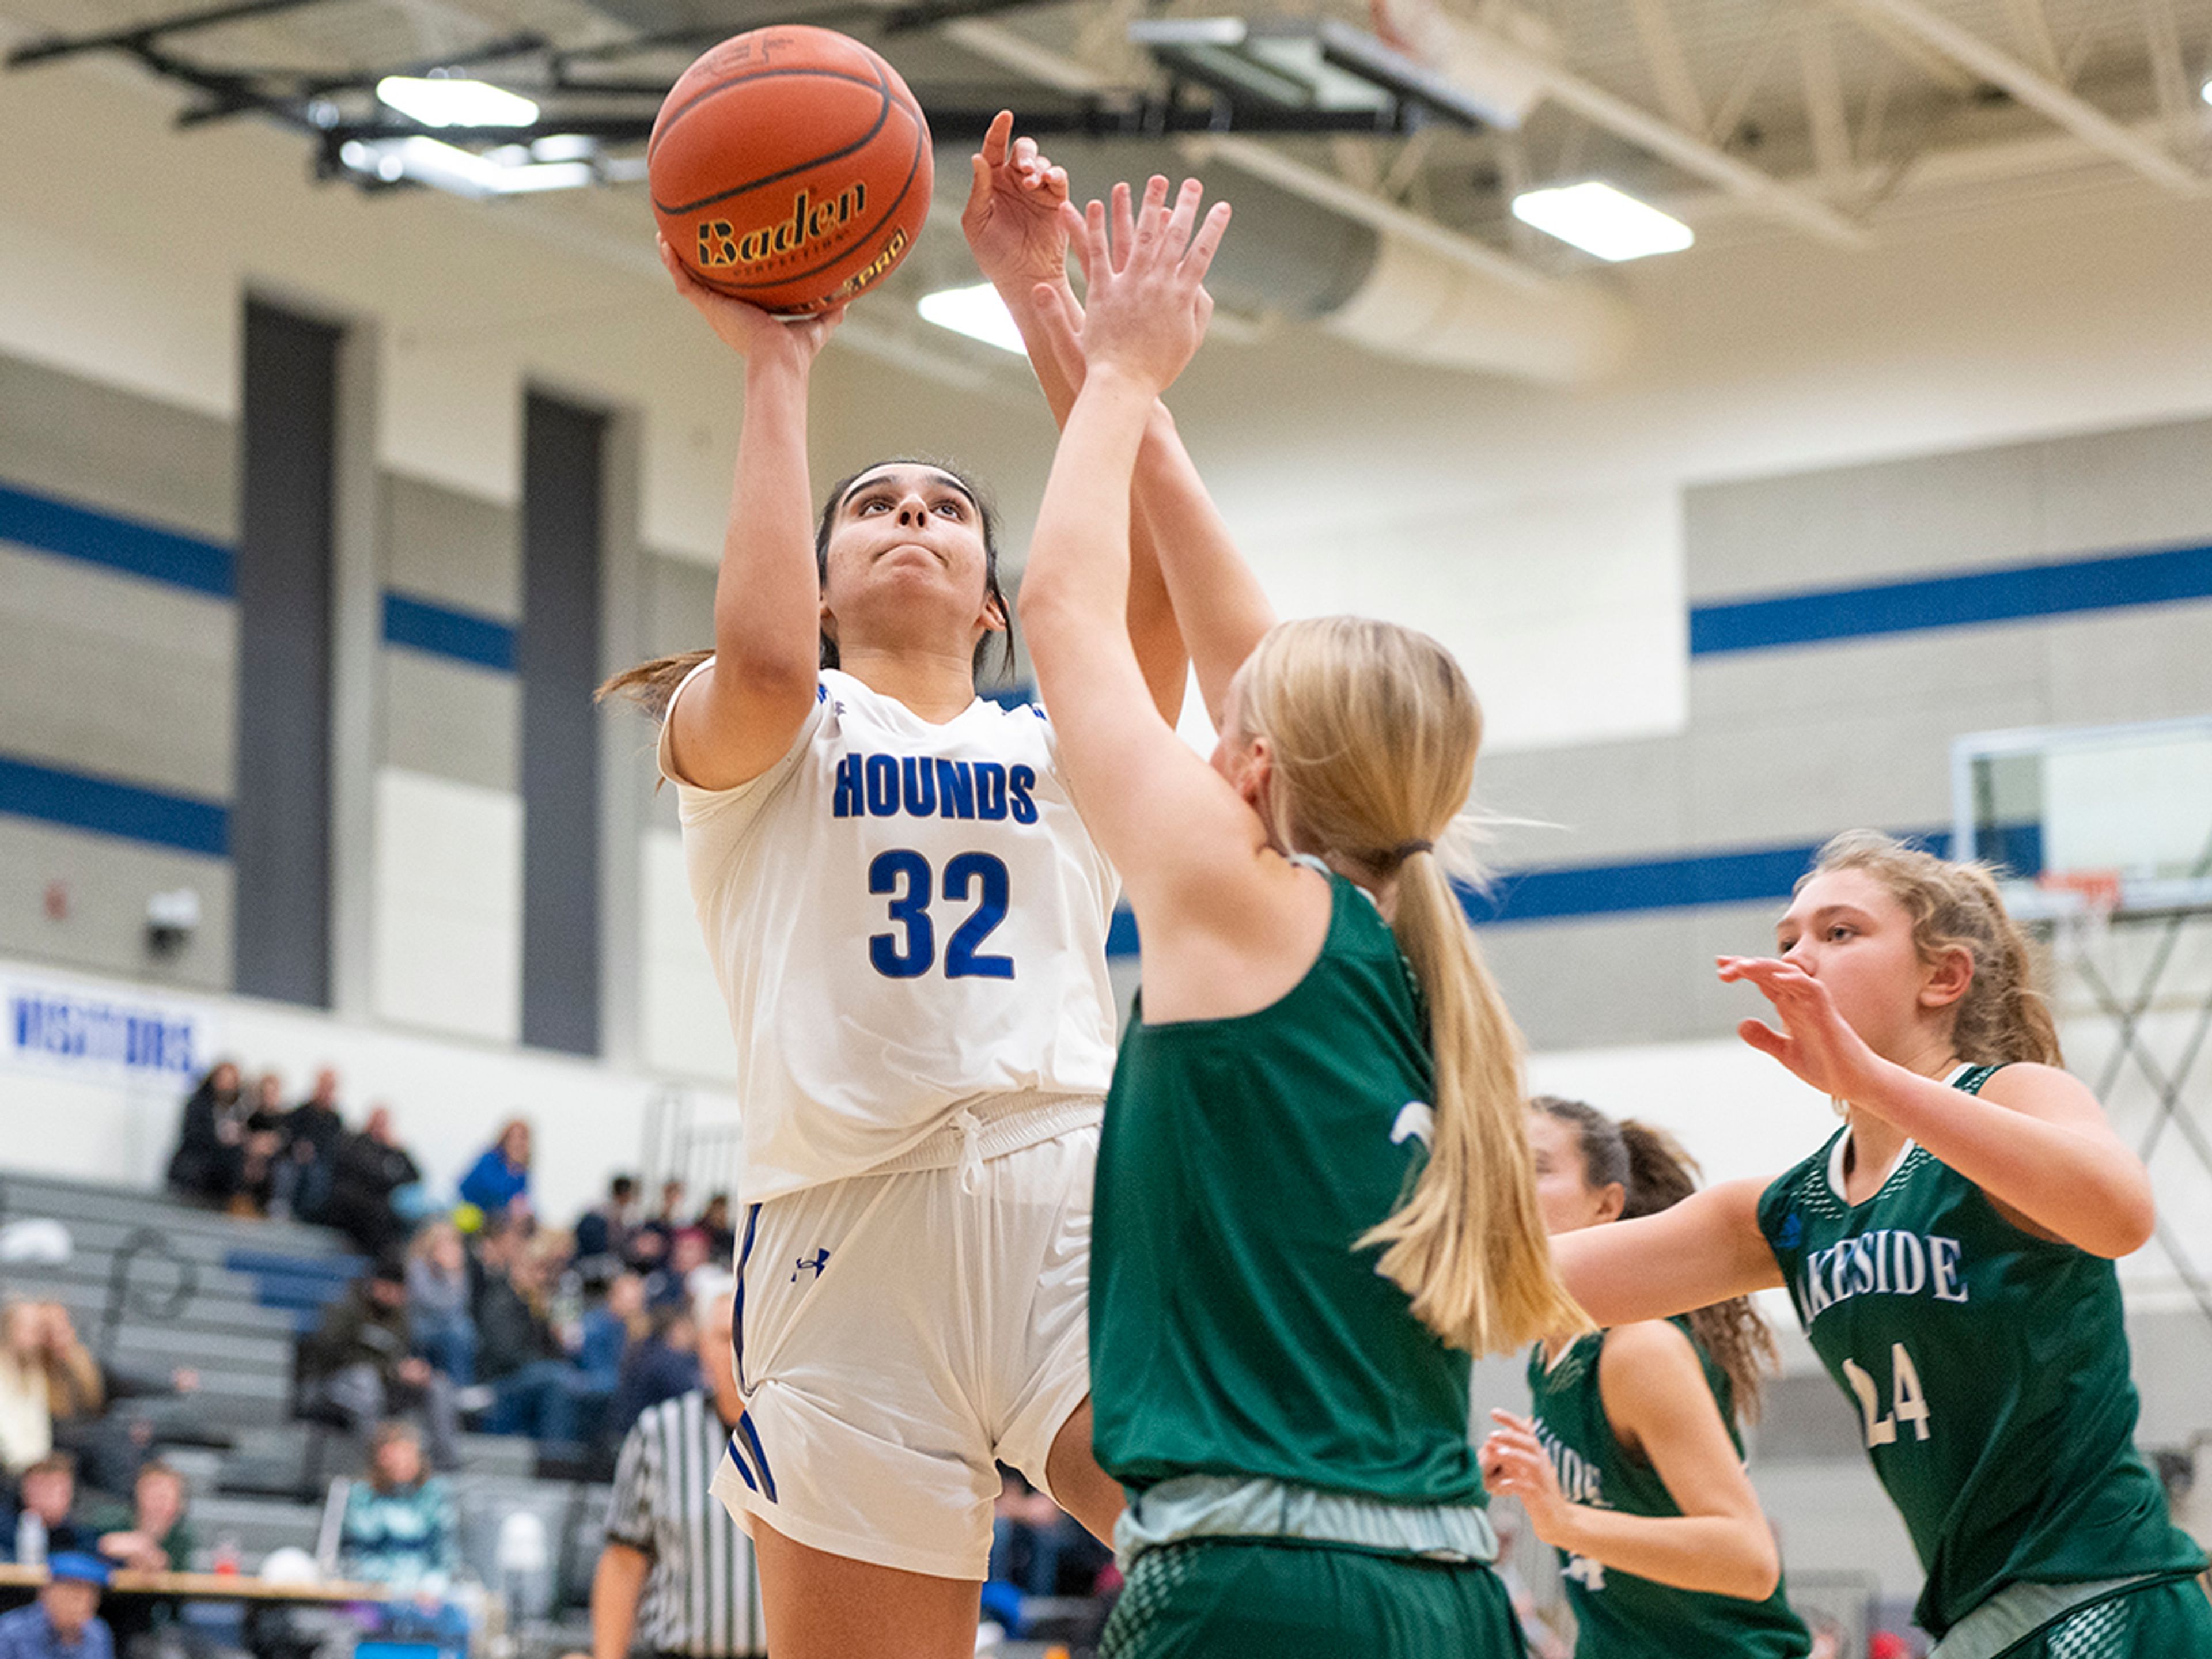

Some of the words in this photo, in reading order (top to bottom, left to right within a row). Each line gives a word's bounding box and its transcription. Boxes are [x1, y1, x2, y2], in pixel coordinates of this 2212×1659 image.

[698, 183, 866, 267] Baden
[832, 752, 1039, 825] HOUNDS
[868, 848, 1015, 980] 32
